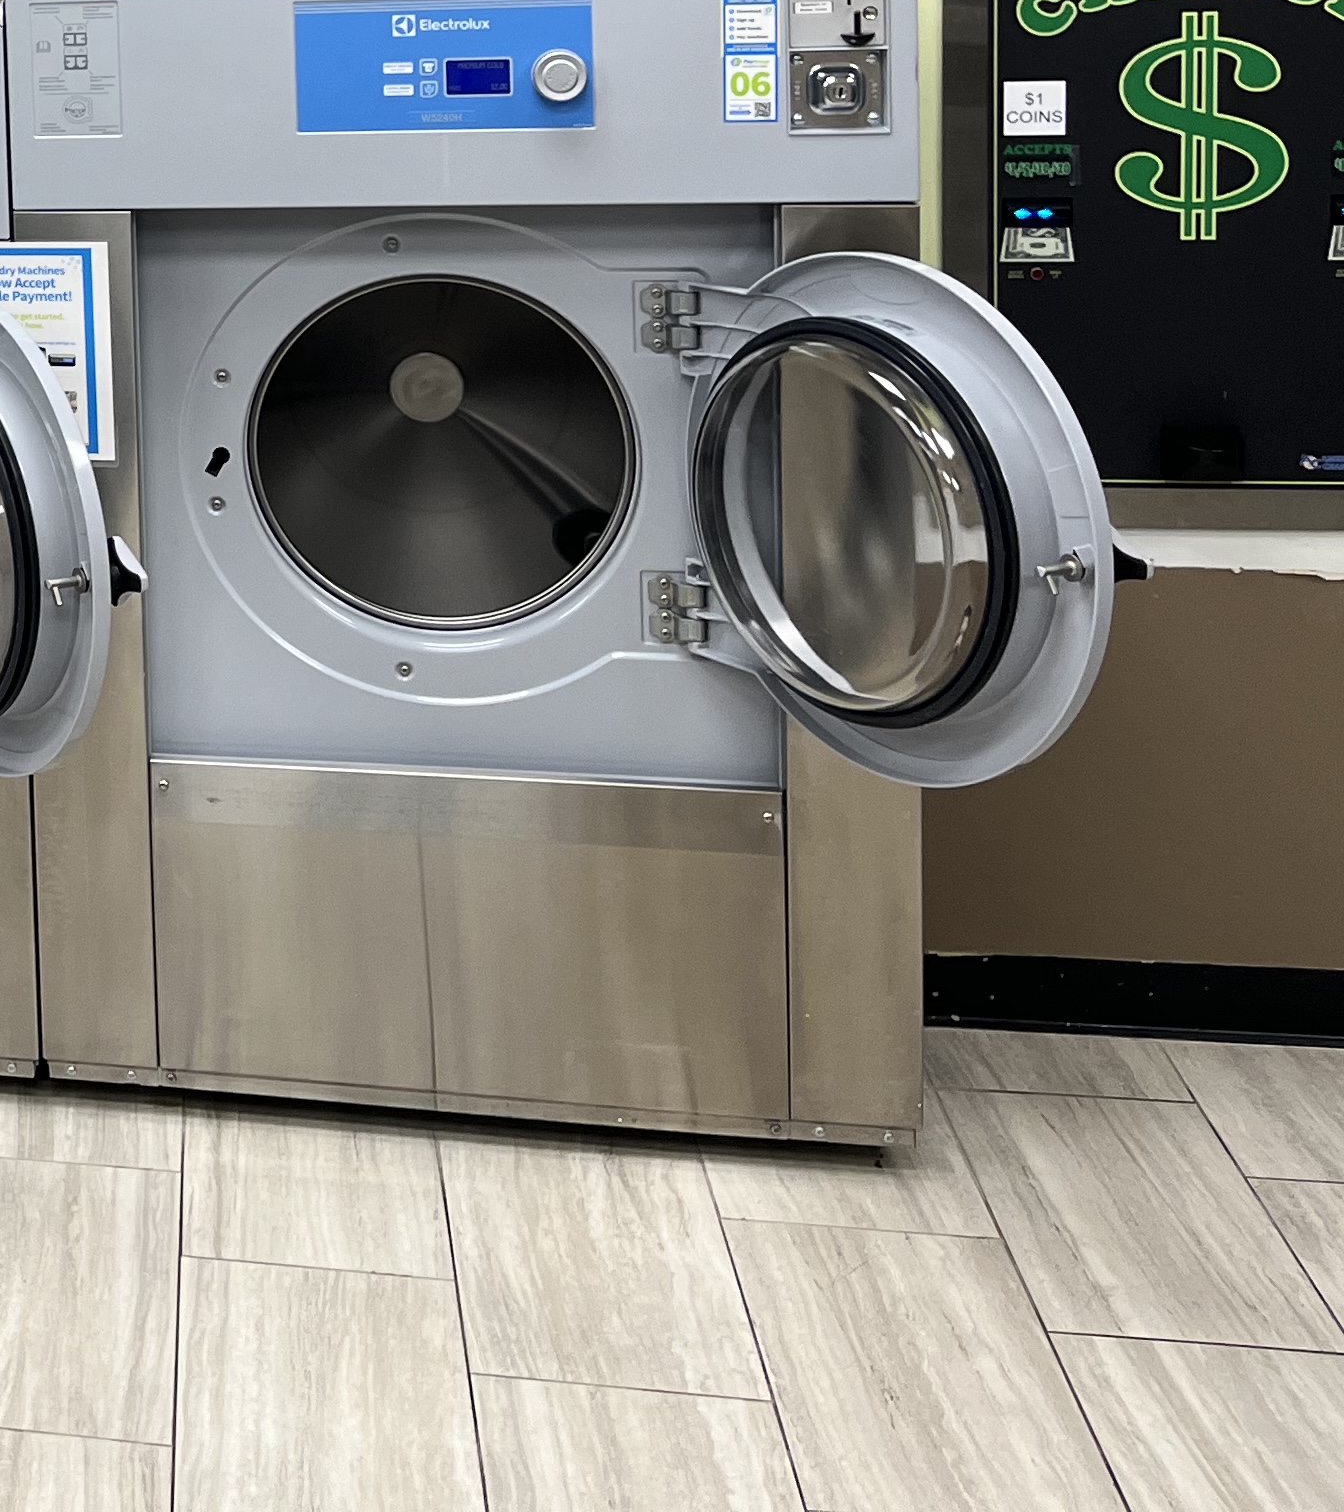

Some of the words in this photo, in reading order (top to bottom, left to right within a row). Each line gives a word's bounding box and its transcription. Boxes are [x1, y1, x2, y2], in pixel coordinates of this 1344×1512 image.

[419, 18, 490, 31] Electrolux
[730, 72, 772, 96] 06
[1025, 92, 1043, 106] $1
[1006, 110, 1063, 124] COINS
[18, 266, 65, 275] Machines
[14, 278, 56, 290] Accept
[12, 291, 72, 304] Payment!
[20, 313, 32, 321] get
[34, 312, 64, 320] started.
